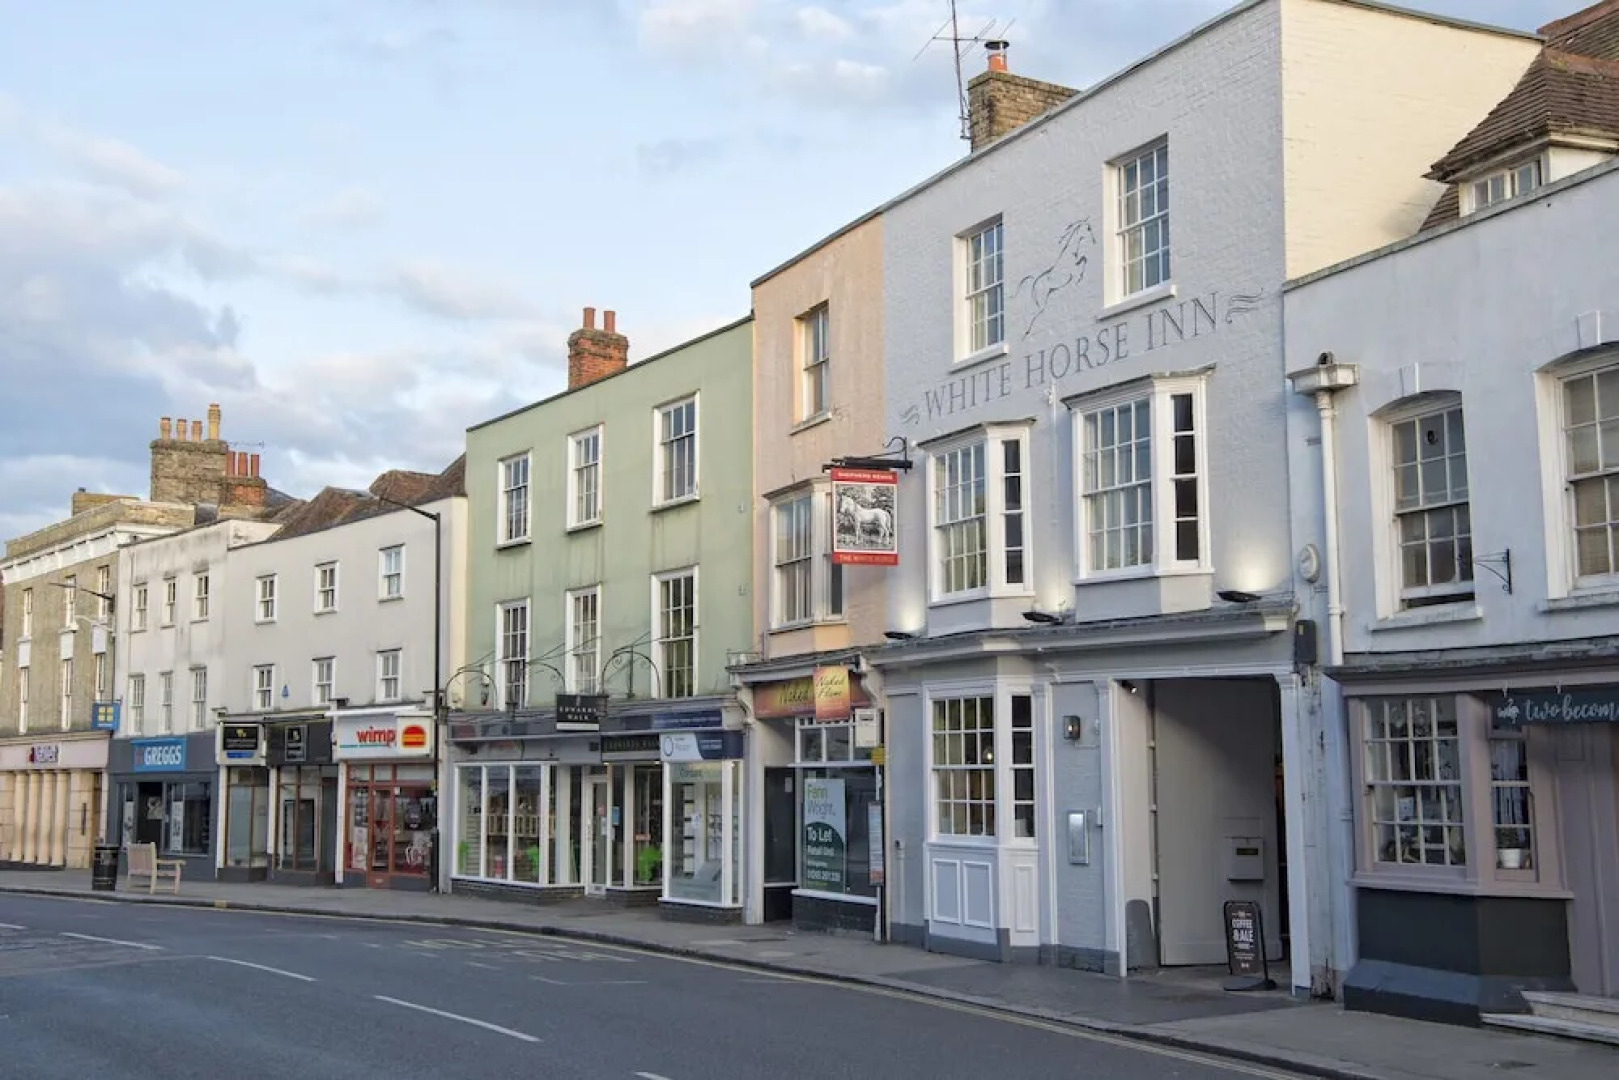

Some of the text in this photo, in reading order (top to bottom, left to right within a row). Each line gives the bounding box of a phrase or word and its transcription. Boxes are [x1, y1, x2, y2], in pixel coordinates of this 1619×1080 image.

[924, 291, 1220, 421] WHITE HORSE INN
[355, 725, 397, 748] wimp
[143, 745, 182, 765] GREGGS
[807, 826, 833, 842] To Let
